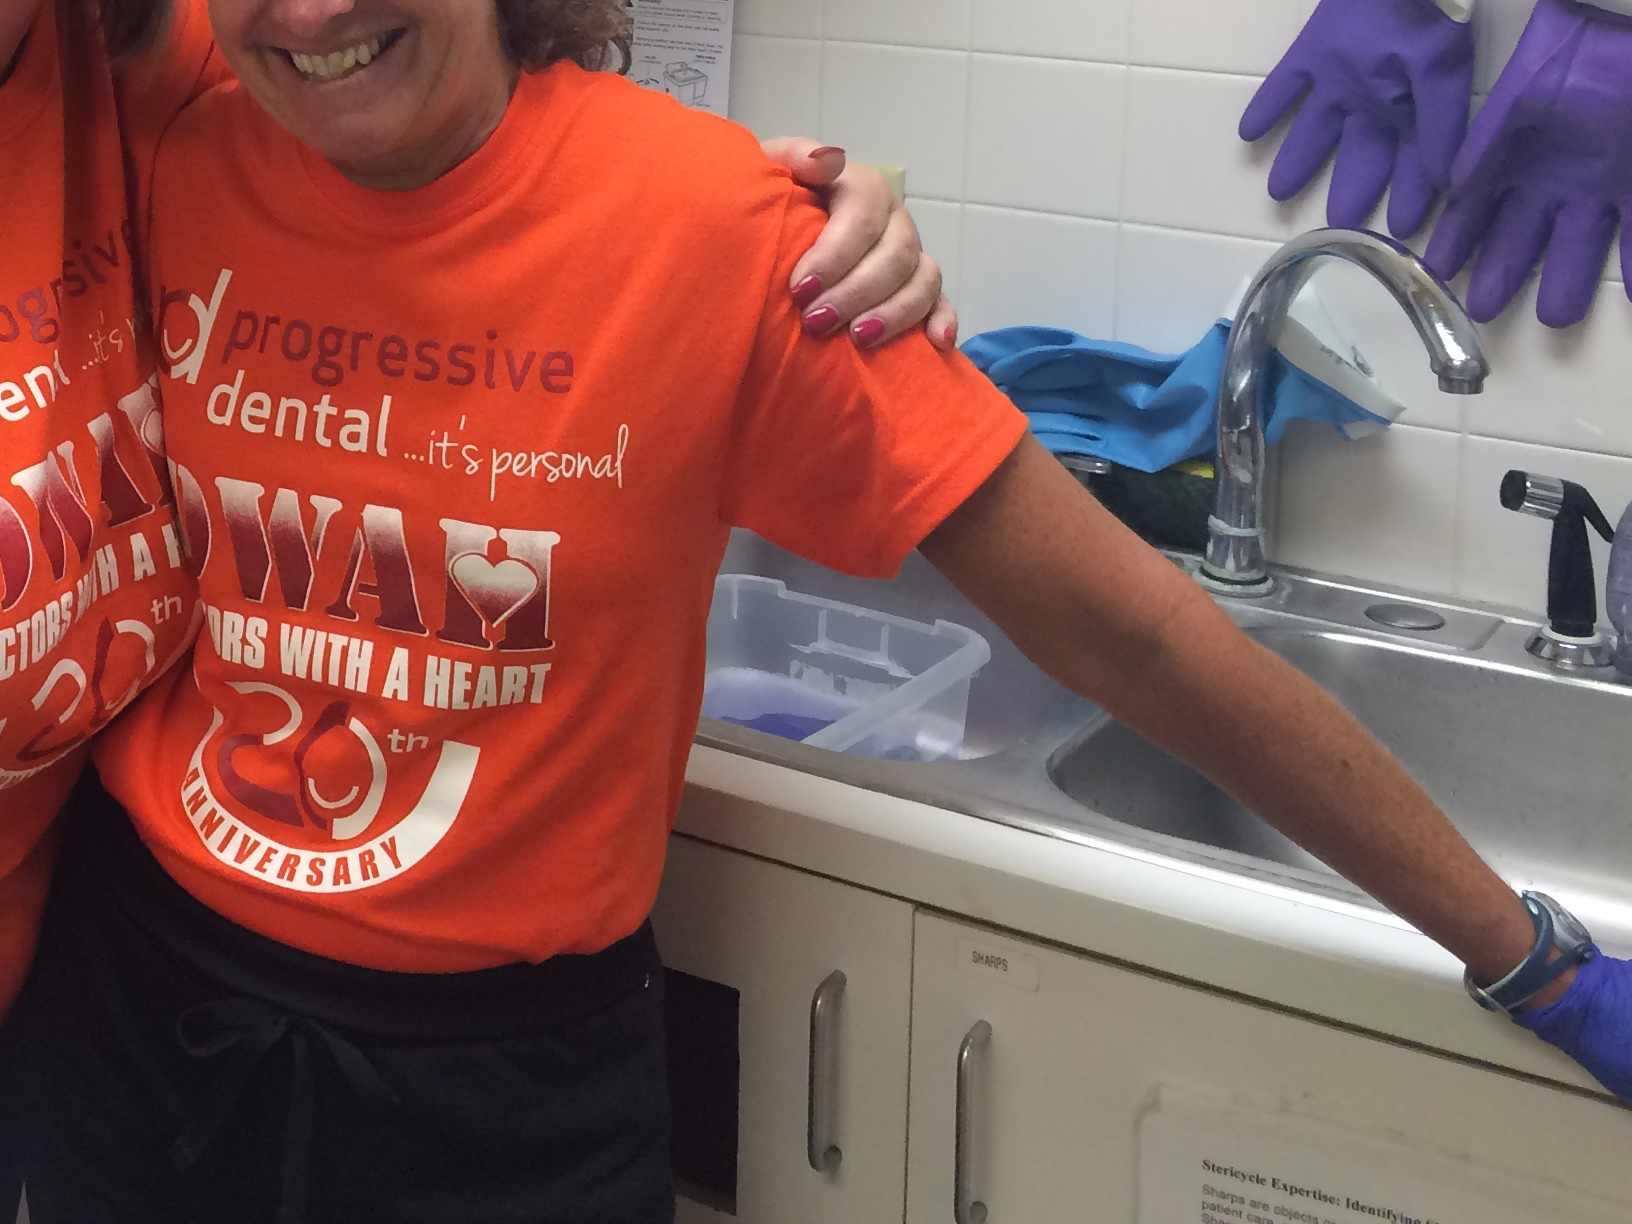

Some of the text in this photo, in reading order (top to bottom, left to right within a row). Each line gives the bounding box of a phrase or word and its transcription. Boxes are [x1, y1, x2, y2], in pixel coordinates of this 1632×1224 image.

[222, 310, 575, 394] progressive
[206, 370, 393, 457] dental
[490, 424, 629, 501] personal
[281, 622, 374, 694] WITH
[382, 646, 409, 702] A
[424, 654, 552, 711] HEART
[184, 767, 404, 888] ANNIVERSARY
[972, 950, 1008, 972] SHARPS
[1201, 1200, 1243, 1219] patient
[1202, 1159, 1267, 1186] Stericycle
[1271, 1176, 1341, 1206] Expertise:
[1202, 1184, 1319, 1224] Sharps are objects
